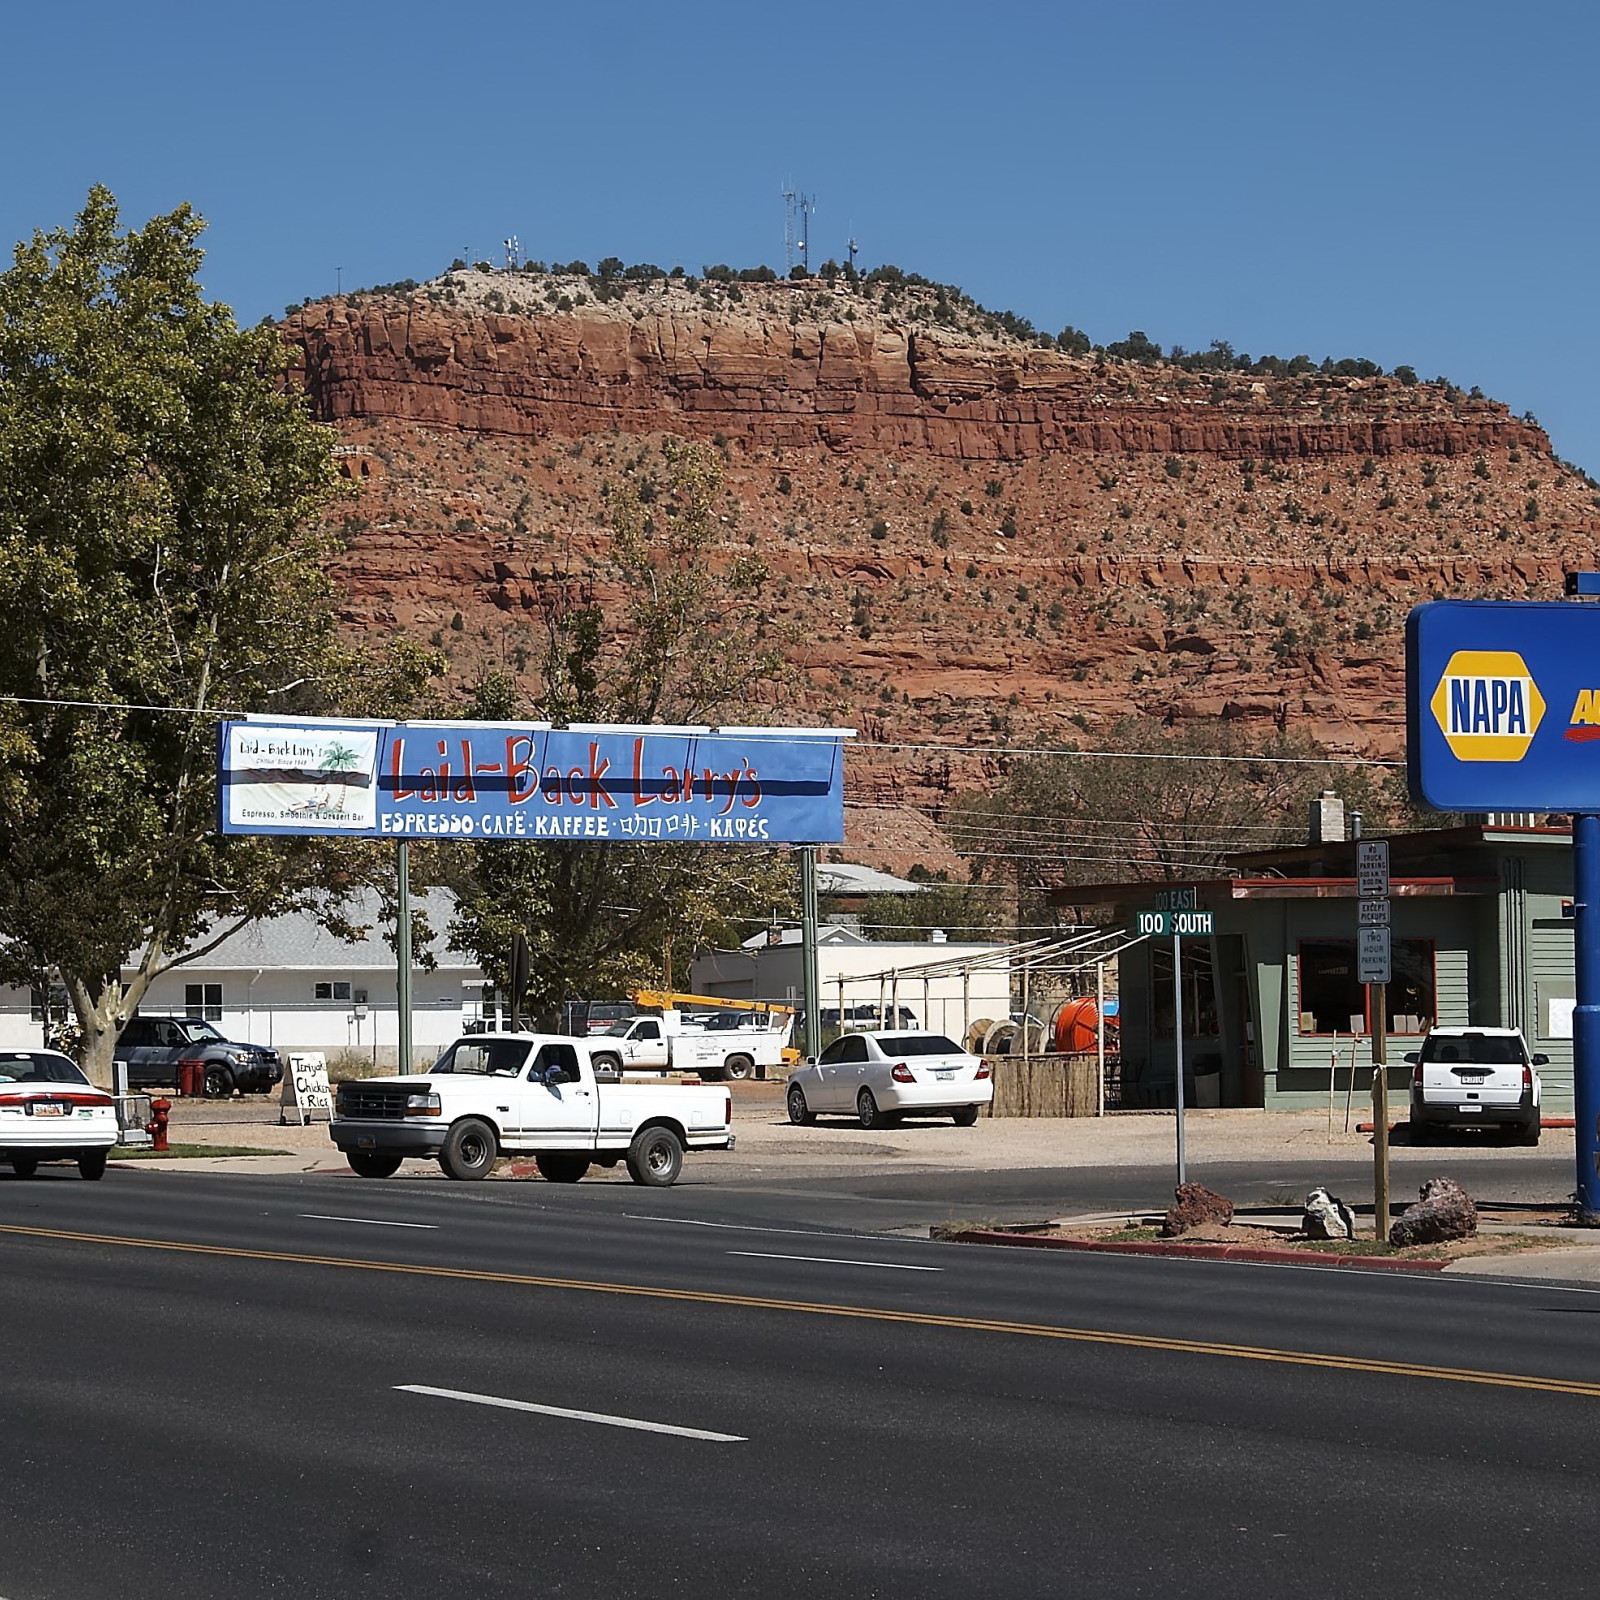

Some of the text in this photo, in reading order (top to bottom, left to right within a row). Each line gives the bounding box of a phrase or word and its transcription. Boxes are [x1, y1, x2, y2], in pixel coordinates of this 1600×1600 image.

[1451, 678, 1526, 734] NAPA
[632, 736, 763, 816] Larry's
[280, 810, 313, 820] Smoothie
[323, 812, 350, 821] Dessert
[352, 813, 365, 821] Bar
[381, 812, 474, 835] ESPRESSO
[535, 814, 609, 837] KAFFEE
[1155, 889, 1194, 911] 100 EAST
[1362, 904, 1385, 912] EXCEPT
[1139, 912, 1212, 933] 100 SOUTH
[1361, 956, 1387, 964] PARKING
[296, 1076, 331, 1093] Chicken
[307, 1094, 329, 1107] Rice
